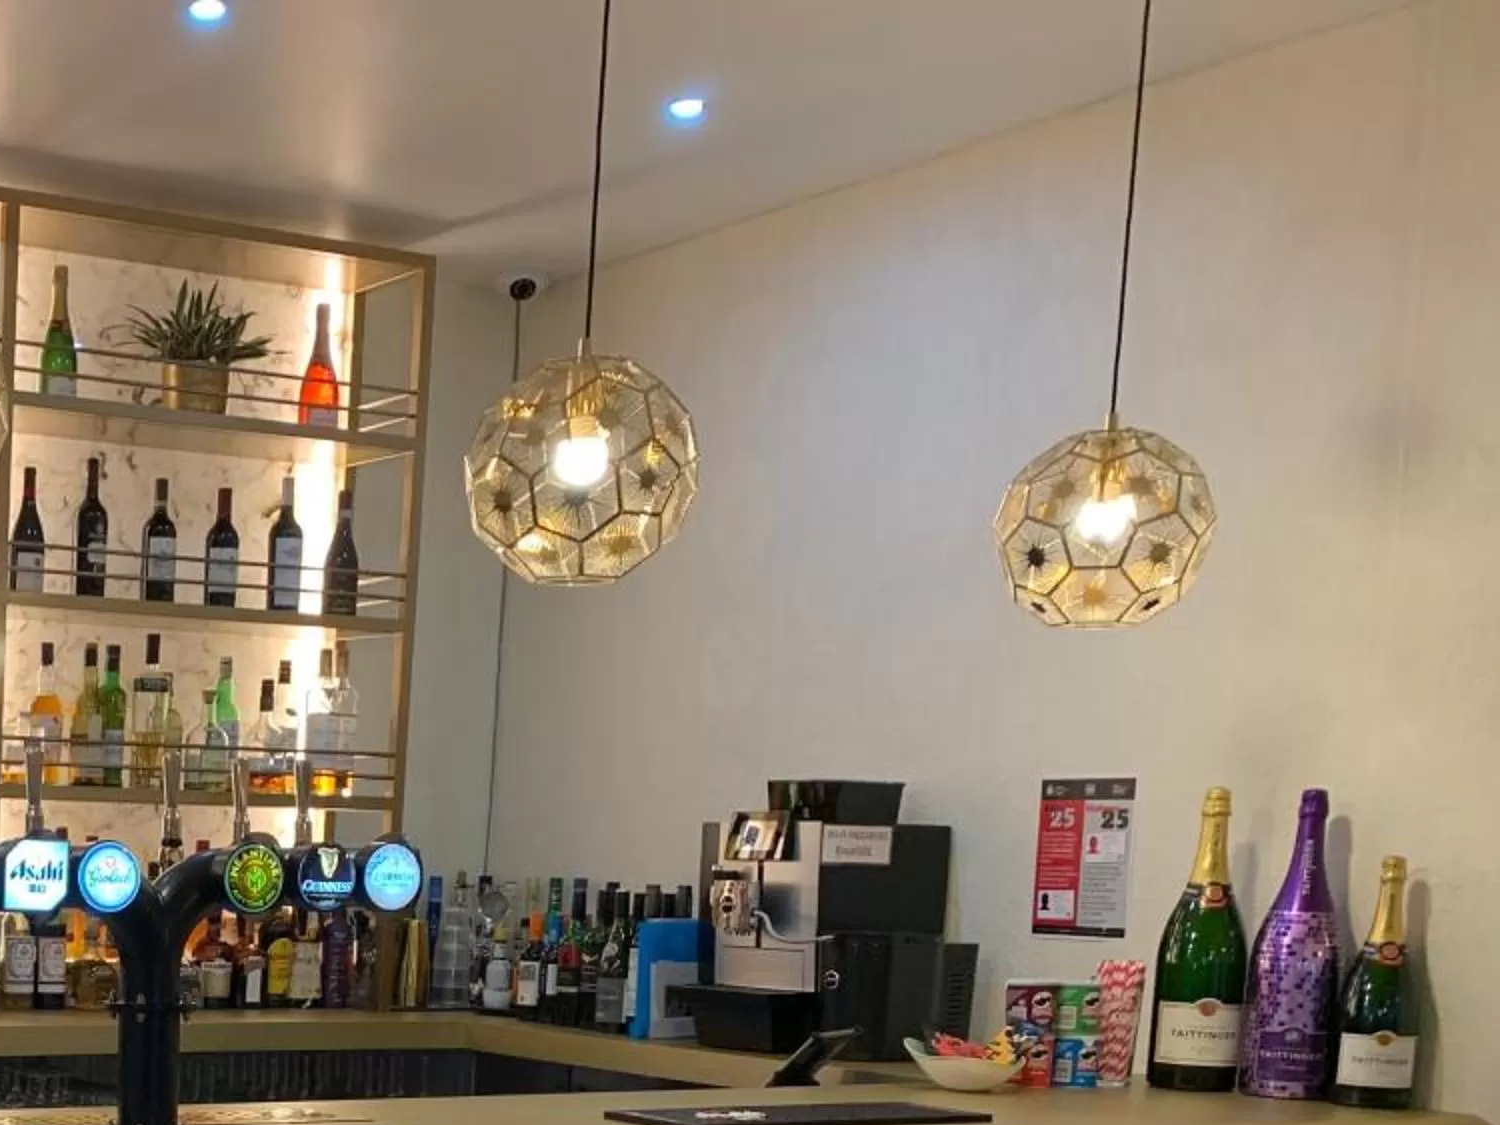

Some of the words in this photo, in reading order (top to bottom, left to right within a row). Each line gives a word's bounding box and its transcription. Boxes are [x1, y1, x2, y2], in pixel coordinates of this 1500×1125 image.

[1049, 807, 1075, 828] 25
[1101, 808, 1129, 829] 25
[10, 859, 64, 882] Asahi
[303, 880, 352, 894] GUINNESS
